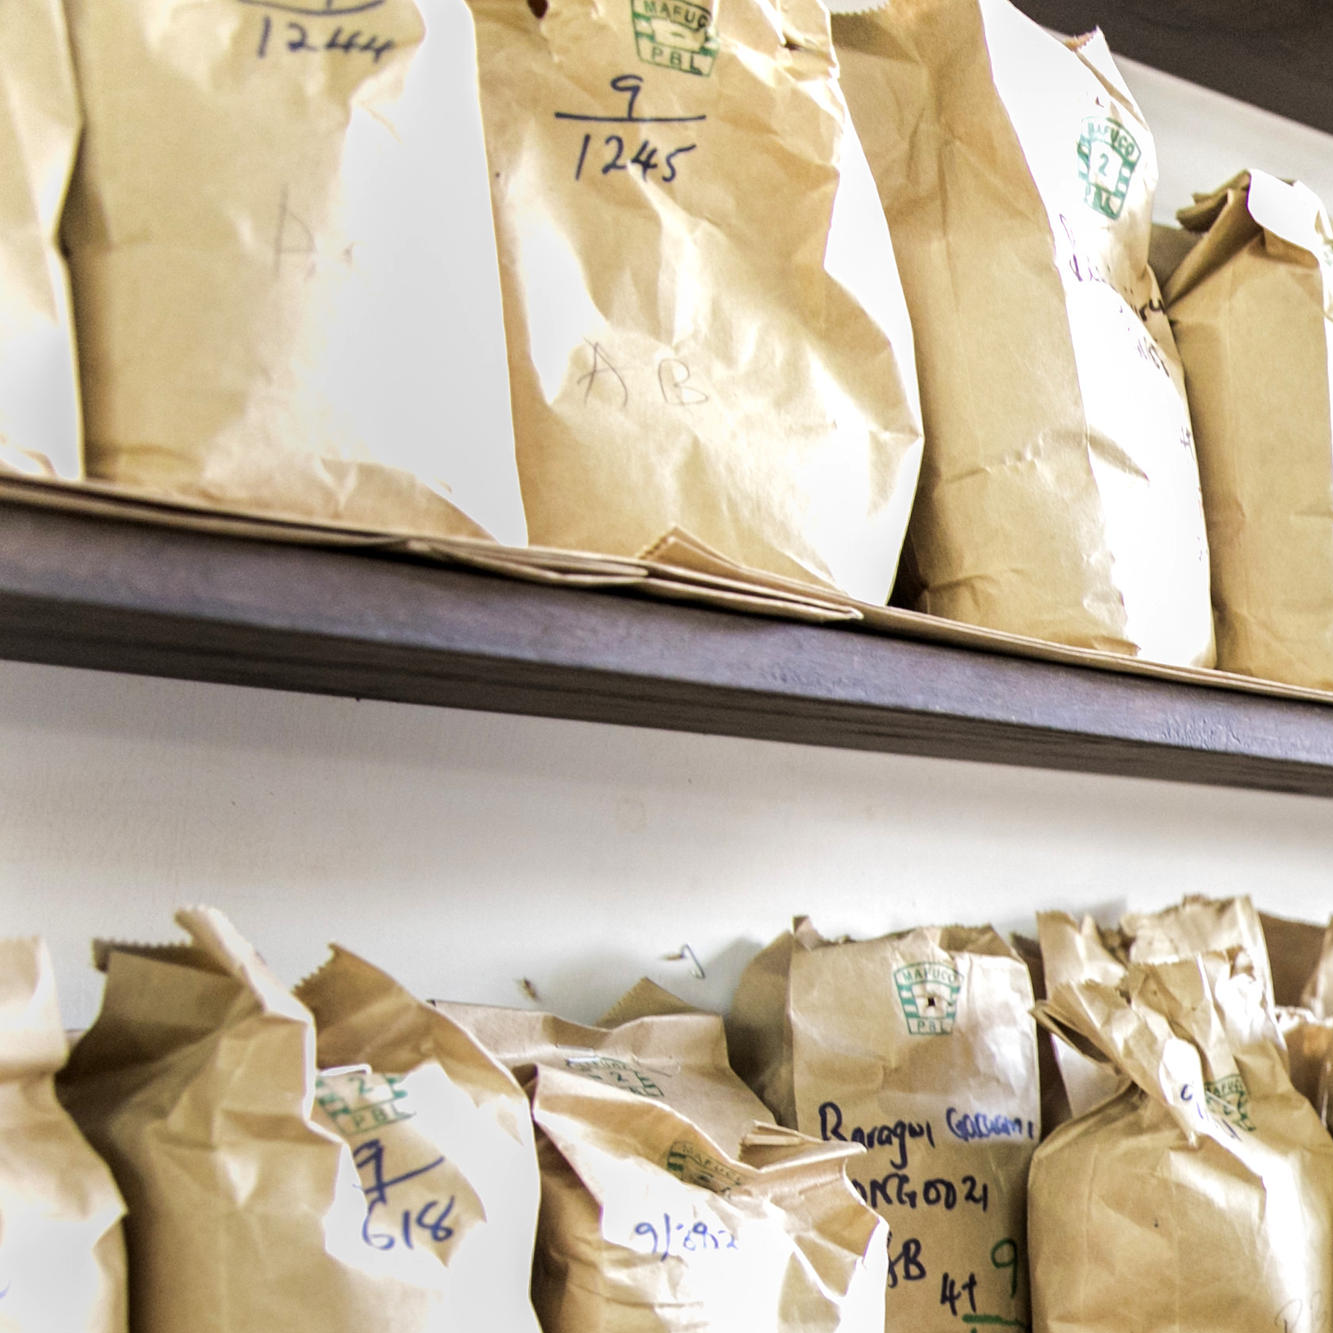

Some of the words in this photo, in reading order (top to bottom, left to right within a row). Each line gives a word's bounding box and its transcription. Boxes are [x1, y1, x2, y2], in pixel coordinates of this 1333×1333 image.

[257, 15, 396, 64] 1244
[610, 74, 643, 119] 9
[575, 133, 698, 183] 1245
[362, 1196, 456, 1250] 618
[990, 1237, 1019, 1299] 9
